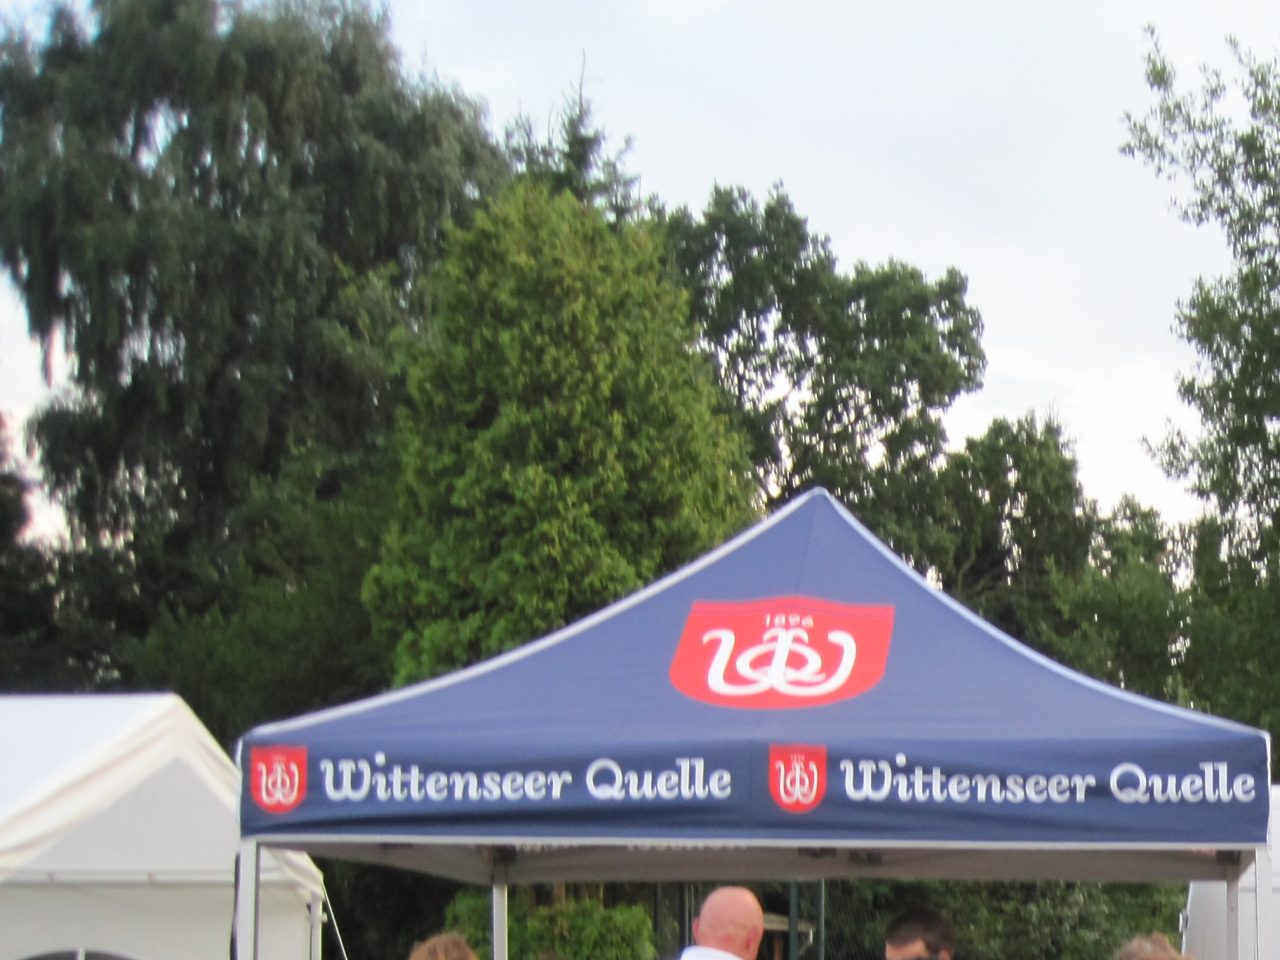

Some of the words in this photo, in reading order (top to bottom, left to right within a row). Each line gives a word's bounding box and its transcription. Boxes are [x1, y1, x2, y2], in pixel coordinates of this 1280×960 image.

[320, 751, 573, 801] Wittenseer
[585, 758, 732, 801] Quelle
[840, 752, 1097, 803] Wittenseer
[1109, 761, 1257, 804] Quelle
